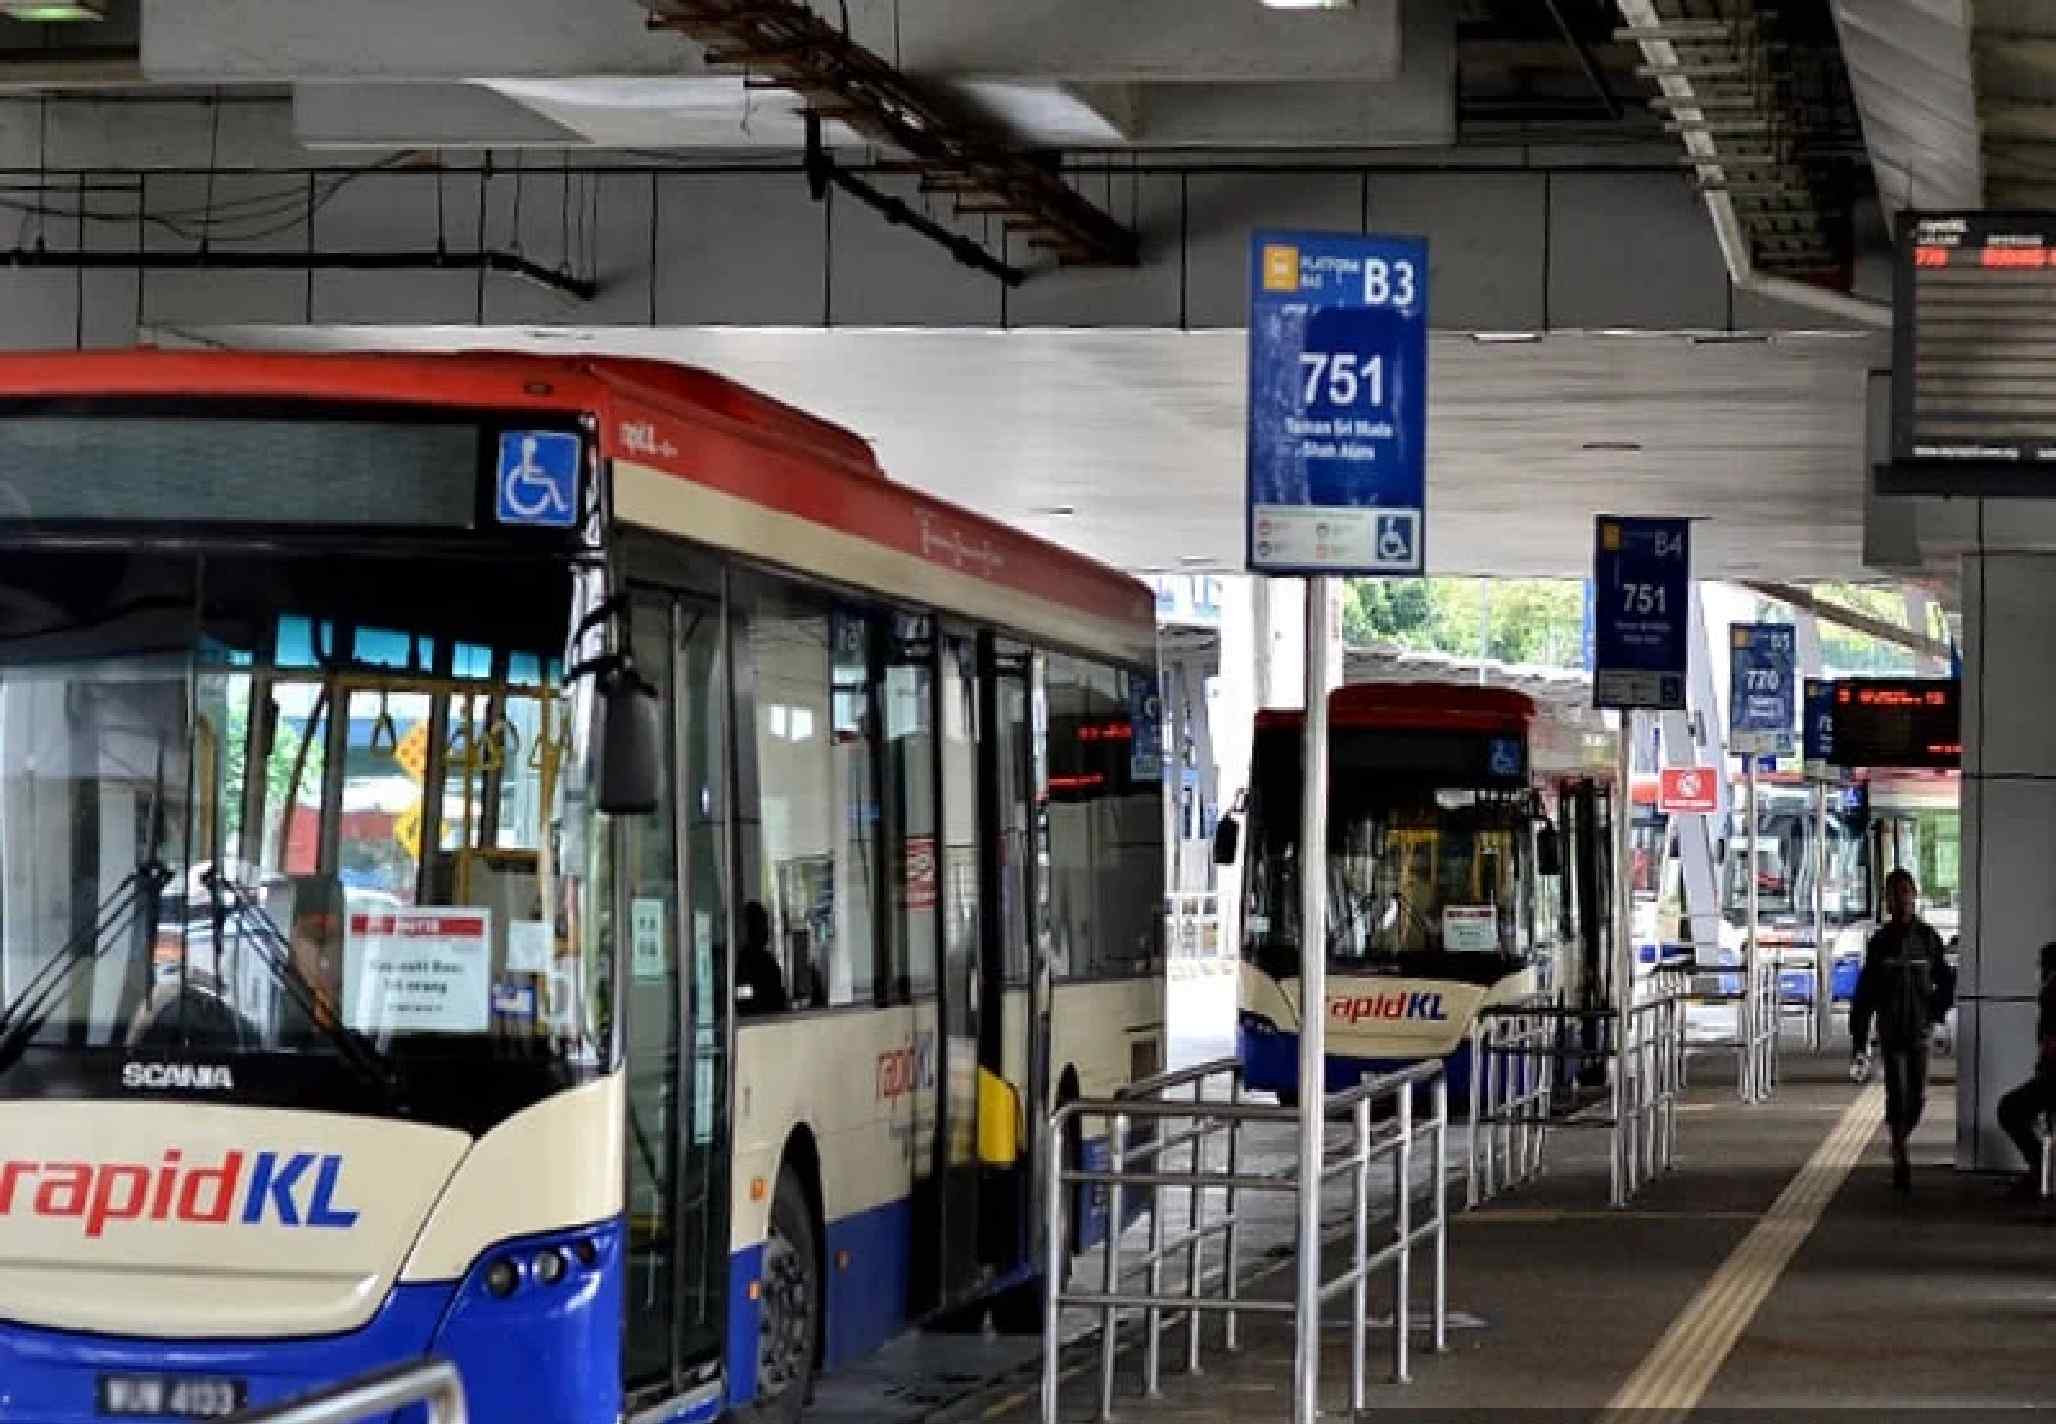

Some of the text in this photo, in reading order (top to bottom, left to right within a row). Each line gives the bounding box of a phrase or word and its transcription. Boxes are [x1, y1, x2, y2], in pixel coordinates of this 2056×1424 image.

[1363, 257, 1415, 305] B3
[1300, 351, 1384, 407] 751
[1654, 530, 1682, 557] B4
[1623, 583, 1667, 614] 751
[1326, 992, 1448, 1024] apidKL
[122, 1063, 233, 1090] SCANIA
[0, 1148, 361, 1238] rapidKL
